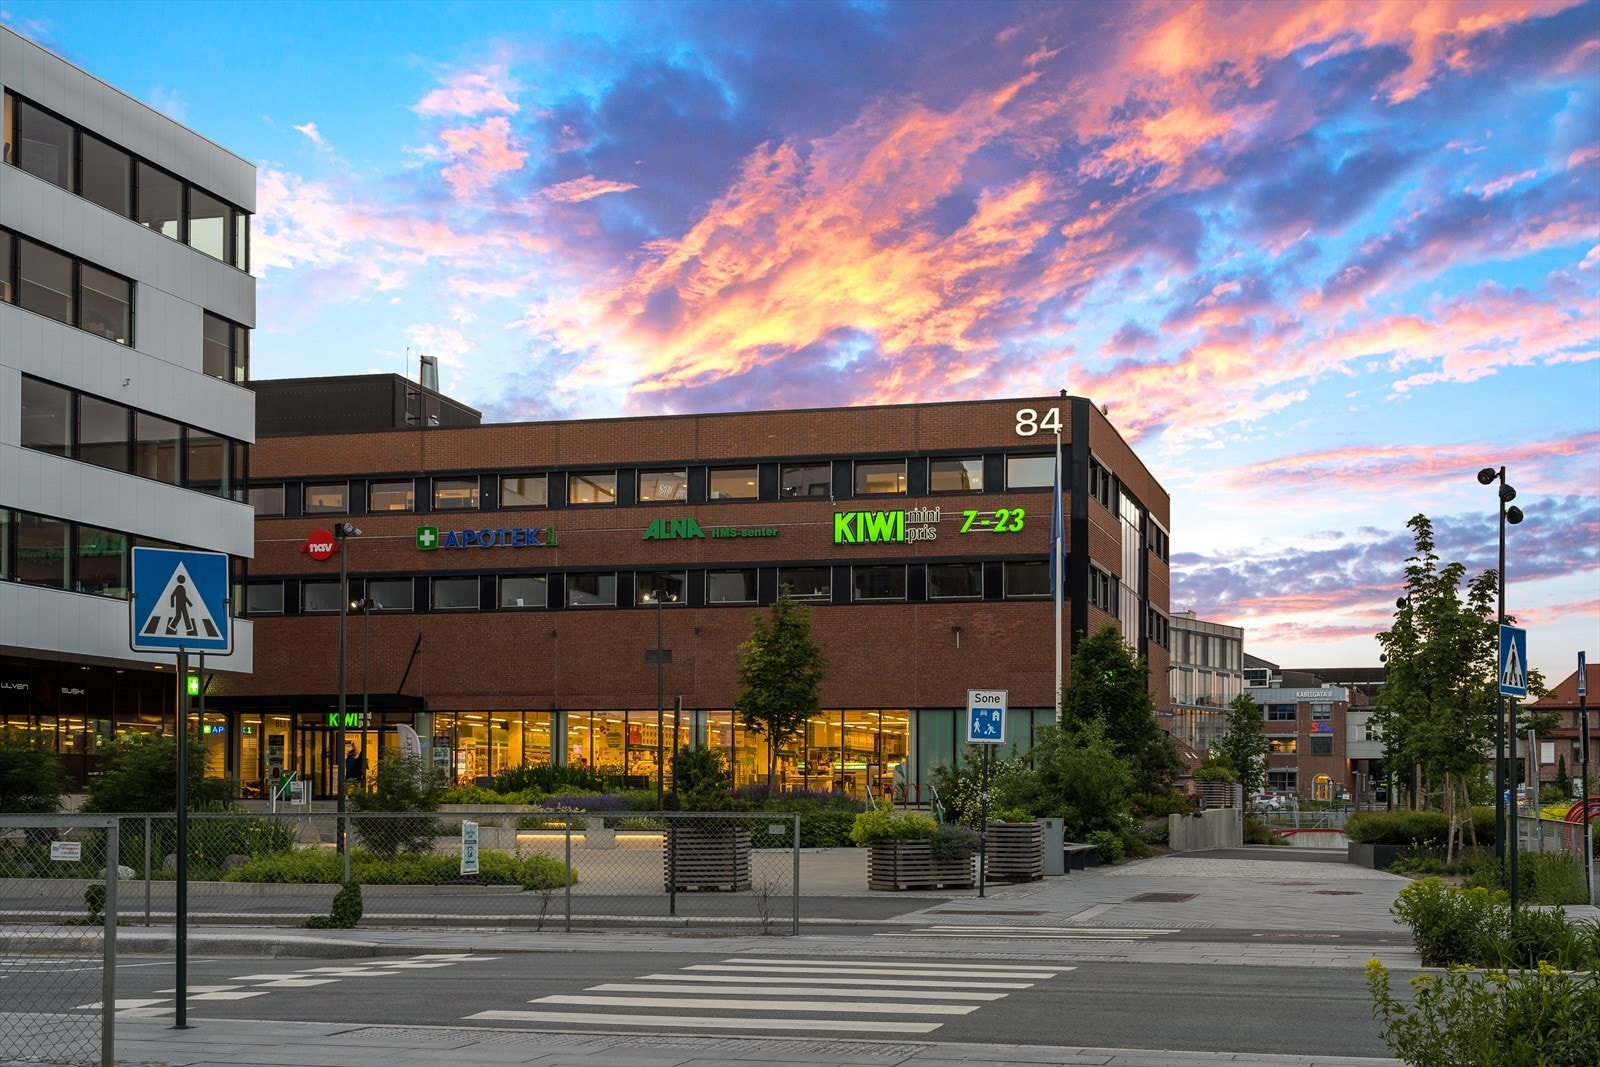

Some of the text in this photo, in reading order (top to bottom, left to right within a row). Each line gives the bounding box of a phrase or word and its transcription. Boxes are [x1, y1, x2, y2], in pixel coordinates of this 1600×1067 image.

[1015, 407, 1063, 437] 84
[908, 506, 941, 523] mini
[641, 517, 778, 540] ALNA HMS-senter
[834, 509, 906, 544] KIWI
[908, 523, 937, 544] pris
[309, 542, 333, 553] nav
[444, 526, 558, 549] APOTEK 1
[974, 692, 1001, 704] Sone
[329, 712, 358, 727] KWI
